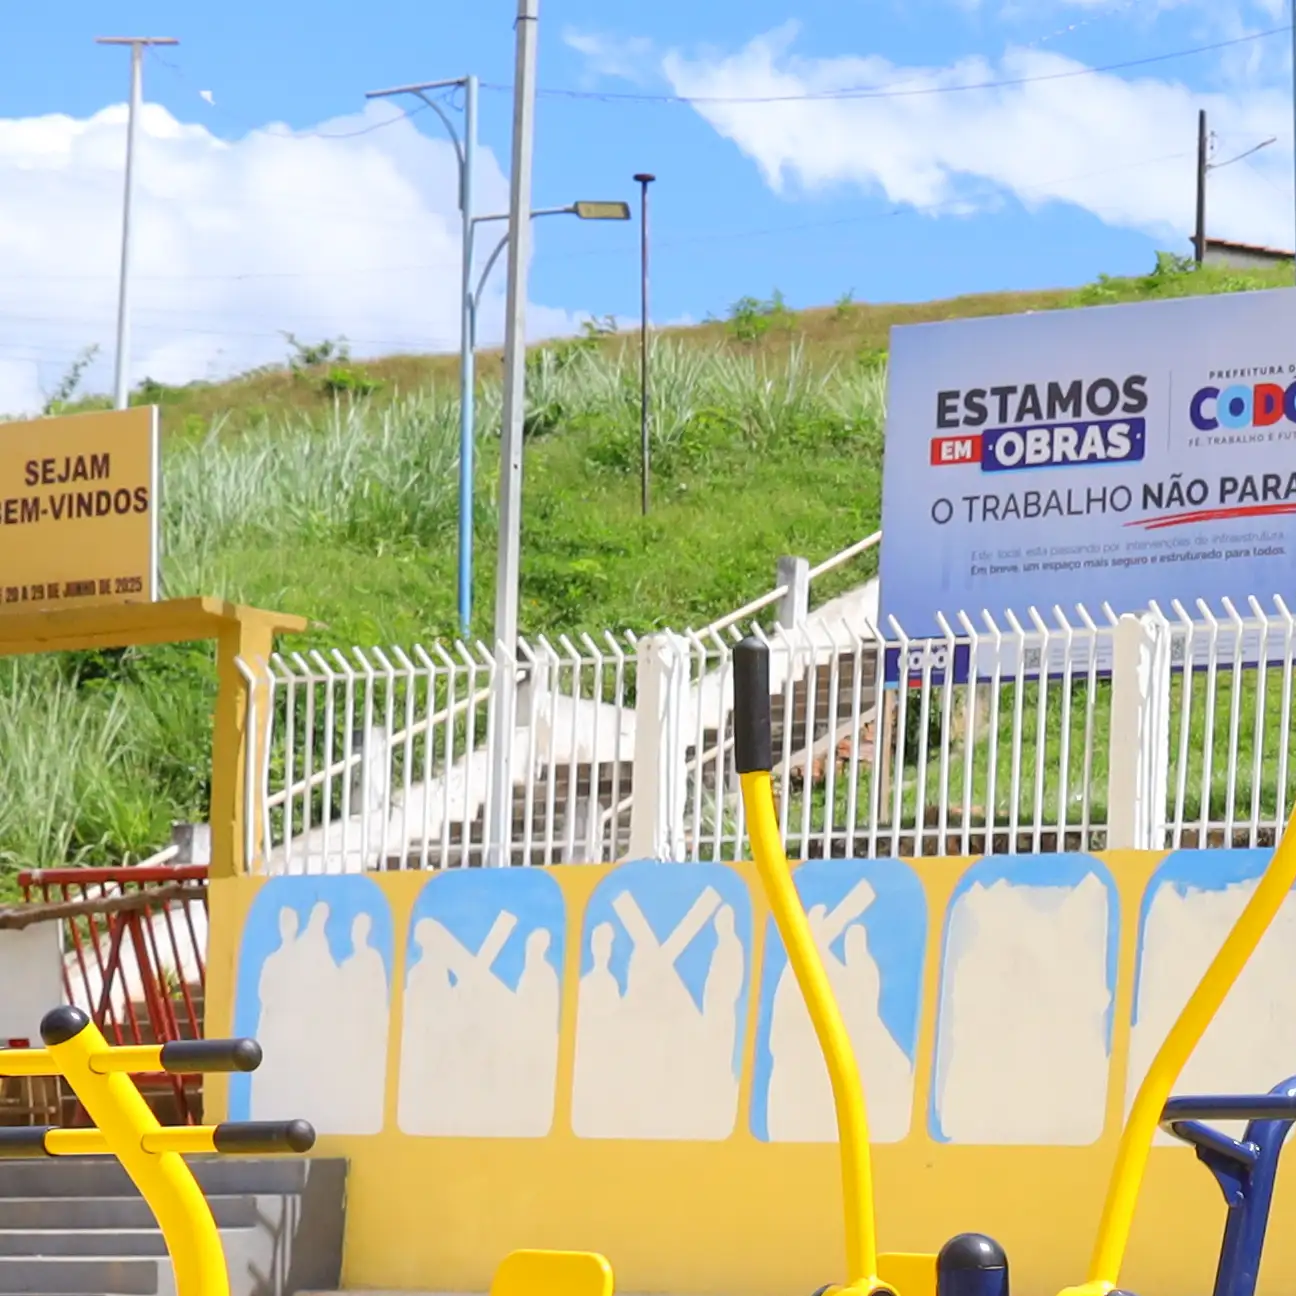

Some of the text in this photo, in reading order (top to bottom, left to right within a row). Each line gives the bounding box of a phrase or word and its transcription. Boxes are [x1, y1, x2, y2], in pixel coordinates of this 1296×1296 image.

[1209, 365, 1284, 380] PREFEITURA
[936, 374, 1149, 429] ESTAMOS
[940, 422, 1132, 467] EM OBRAS
[1207, 432, 1264, 445] TRABALHO
[1268, 431, 1274, 442] E
[24, 452, 111, 487] SEJAM
[0, 486, 148, 525] EM-VINDOS
[931, 497, 954, 525] O
[962, 485, 1133, 523] TRABALHO
[1142, 472, 1209, 511] NÃO
[971, 564, 988, 576] Em
[1023, 561, 1040, 572] um
[1042, 558, 1082, 572] espaço
[1084, 556, 1109, 568] mais
[1111, 554, 1148, 568] seguro
[1150, 554, 1158, 564] e
[1159, 548, 1223, 562] estruturado
[1225, 547, 1250, 561] para
[47, 582, 60, 599] DE
[99, 578, 112, 595] DE
[114, 575, 142, 594] 2025
